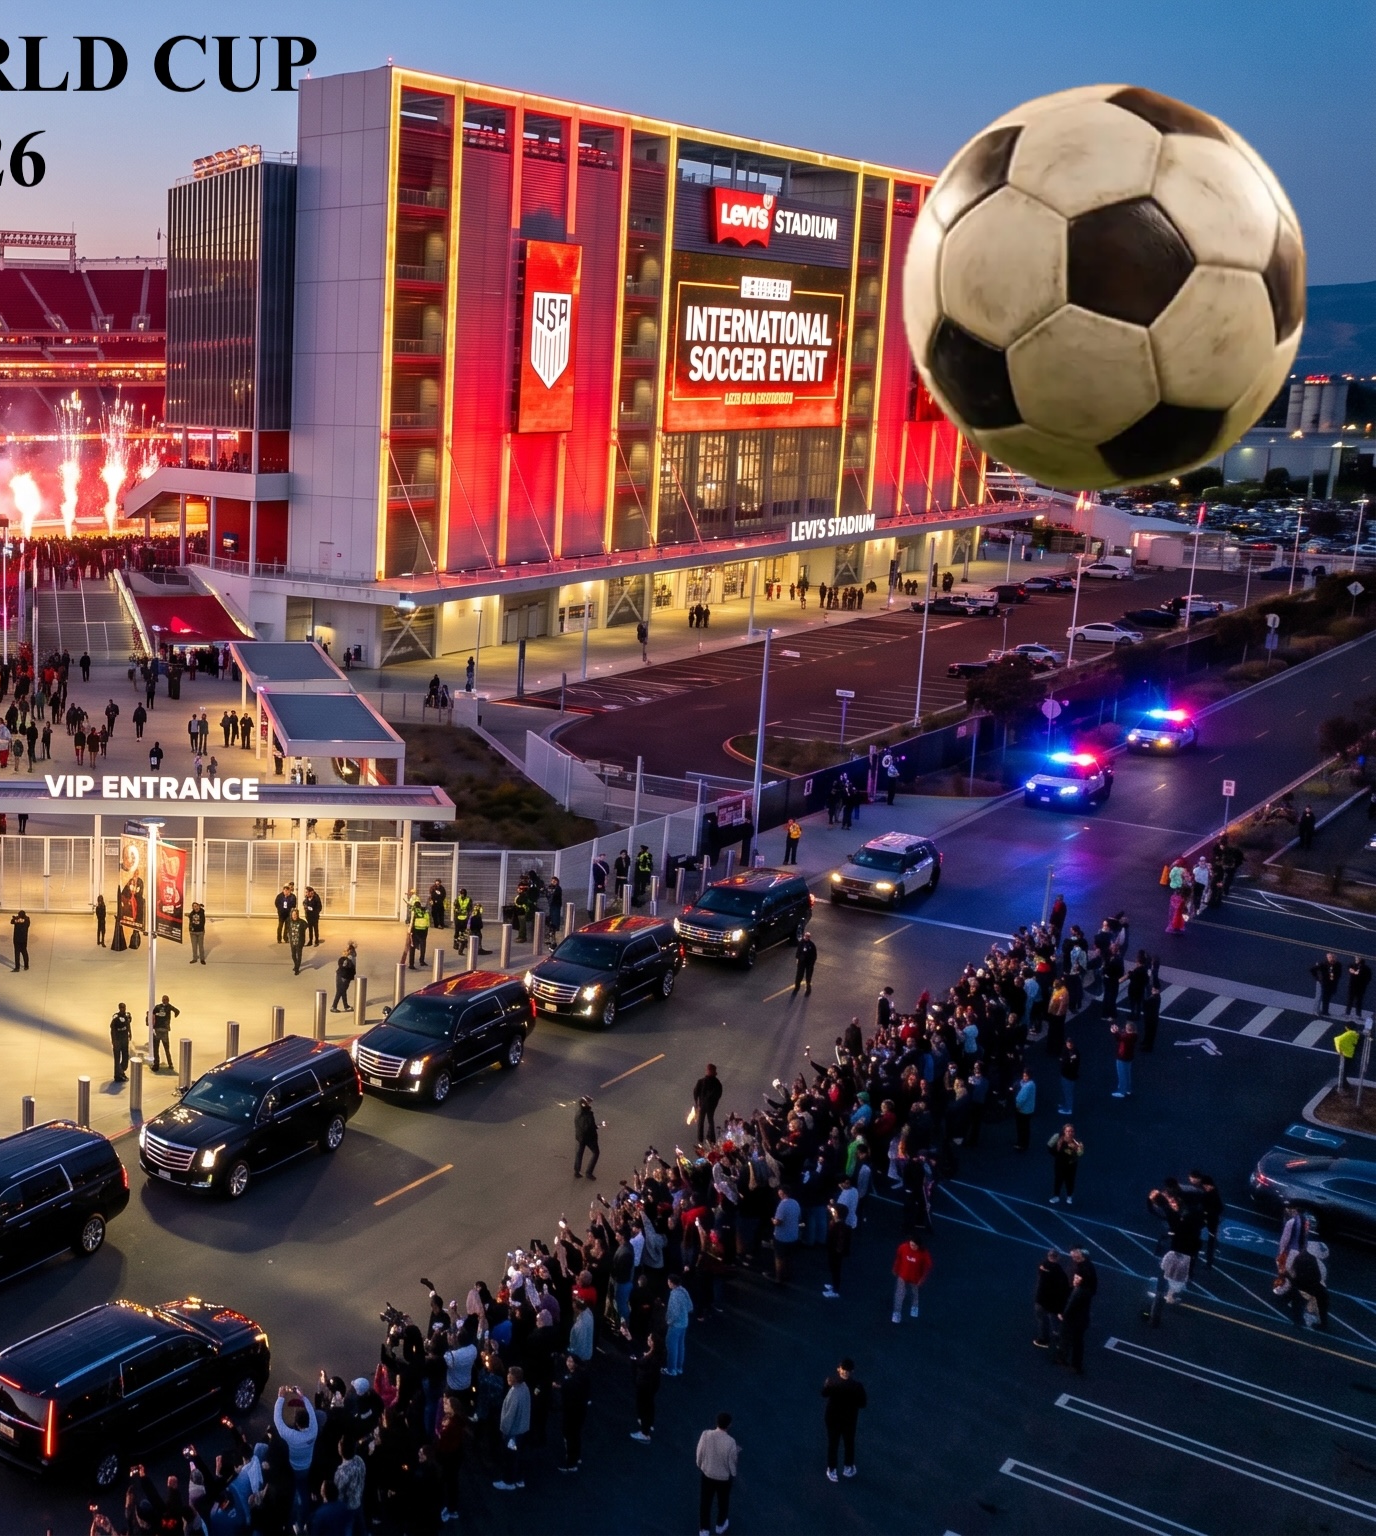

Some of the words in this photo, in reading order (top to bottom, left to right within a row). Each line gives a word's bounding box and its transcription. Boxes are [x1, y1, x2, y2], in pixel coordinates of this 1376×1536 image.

[774, 209, 838, 240] STADIUM
[535, 297, 568, 333] USA
[685, 305, 832, 347] INTERNATIONAL
[688, 345, 767, 382] SOCCER
[769, 348, 828, 382] EVENT
[791, 518, 827, 542] LEVI'S
[827, 513, 876, 538] STADIUM
[44, 774, 95, 798] VIP
[102, 776, 259, 801] ENTRANCE
